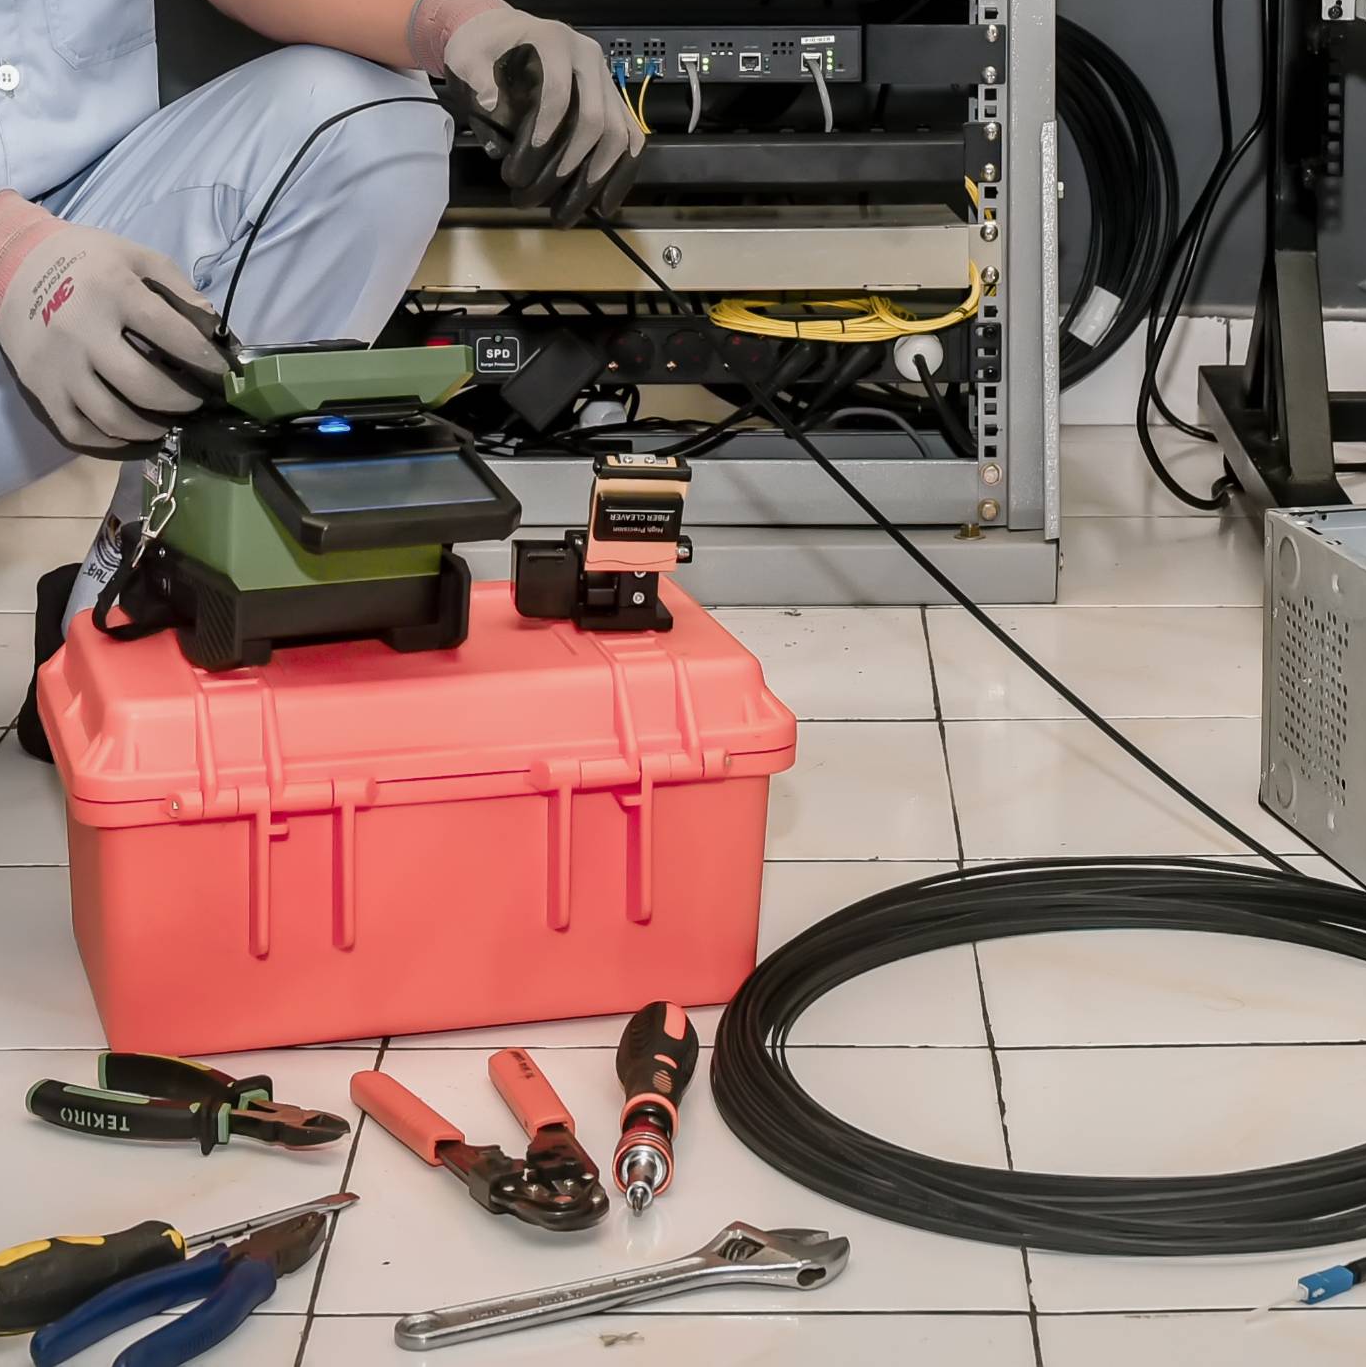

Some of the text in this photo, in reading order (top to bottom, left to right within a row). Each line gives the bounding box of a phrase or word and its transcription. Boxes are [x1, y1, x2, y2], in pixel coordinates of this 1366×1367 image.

[42, 276, 74, 328] 3M
[486, 348, 510, 359] SPD
[610, 513, 670, 522] FIBER CLEAVER
[60, 1107, 130, 1132] TEKIRO
